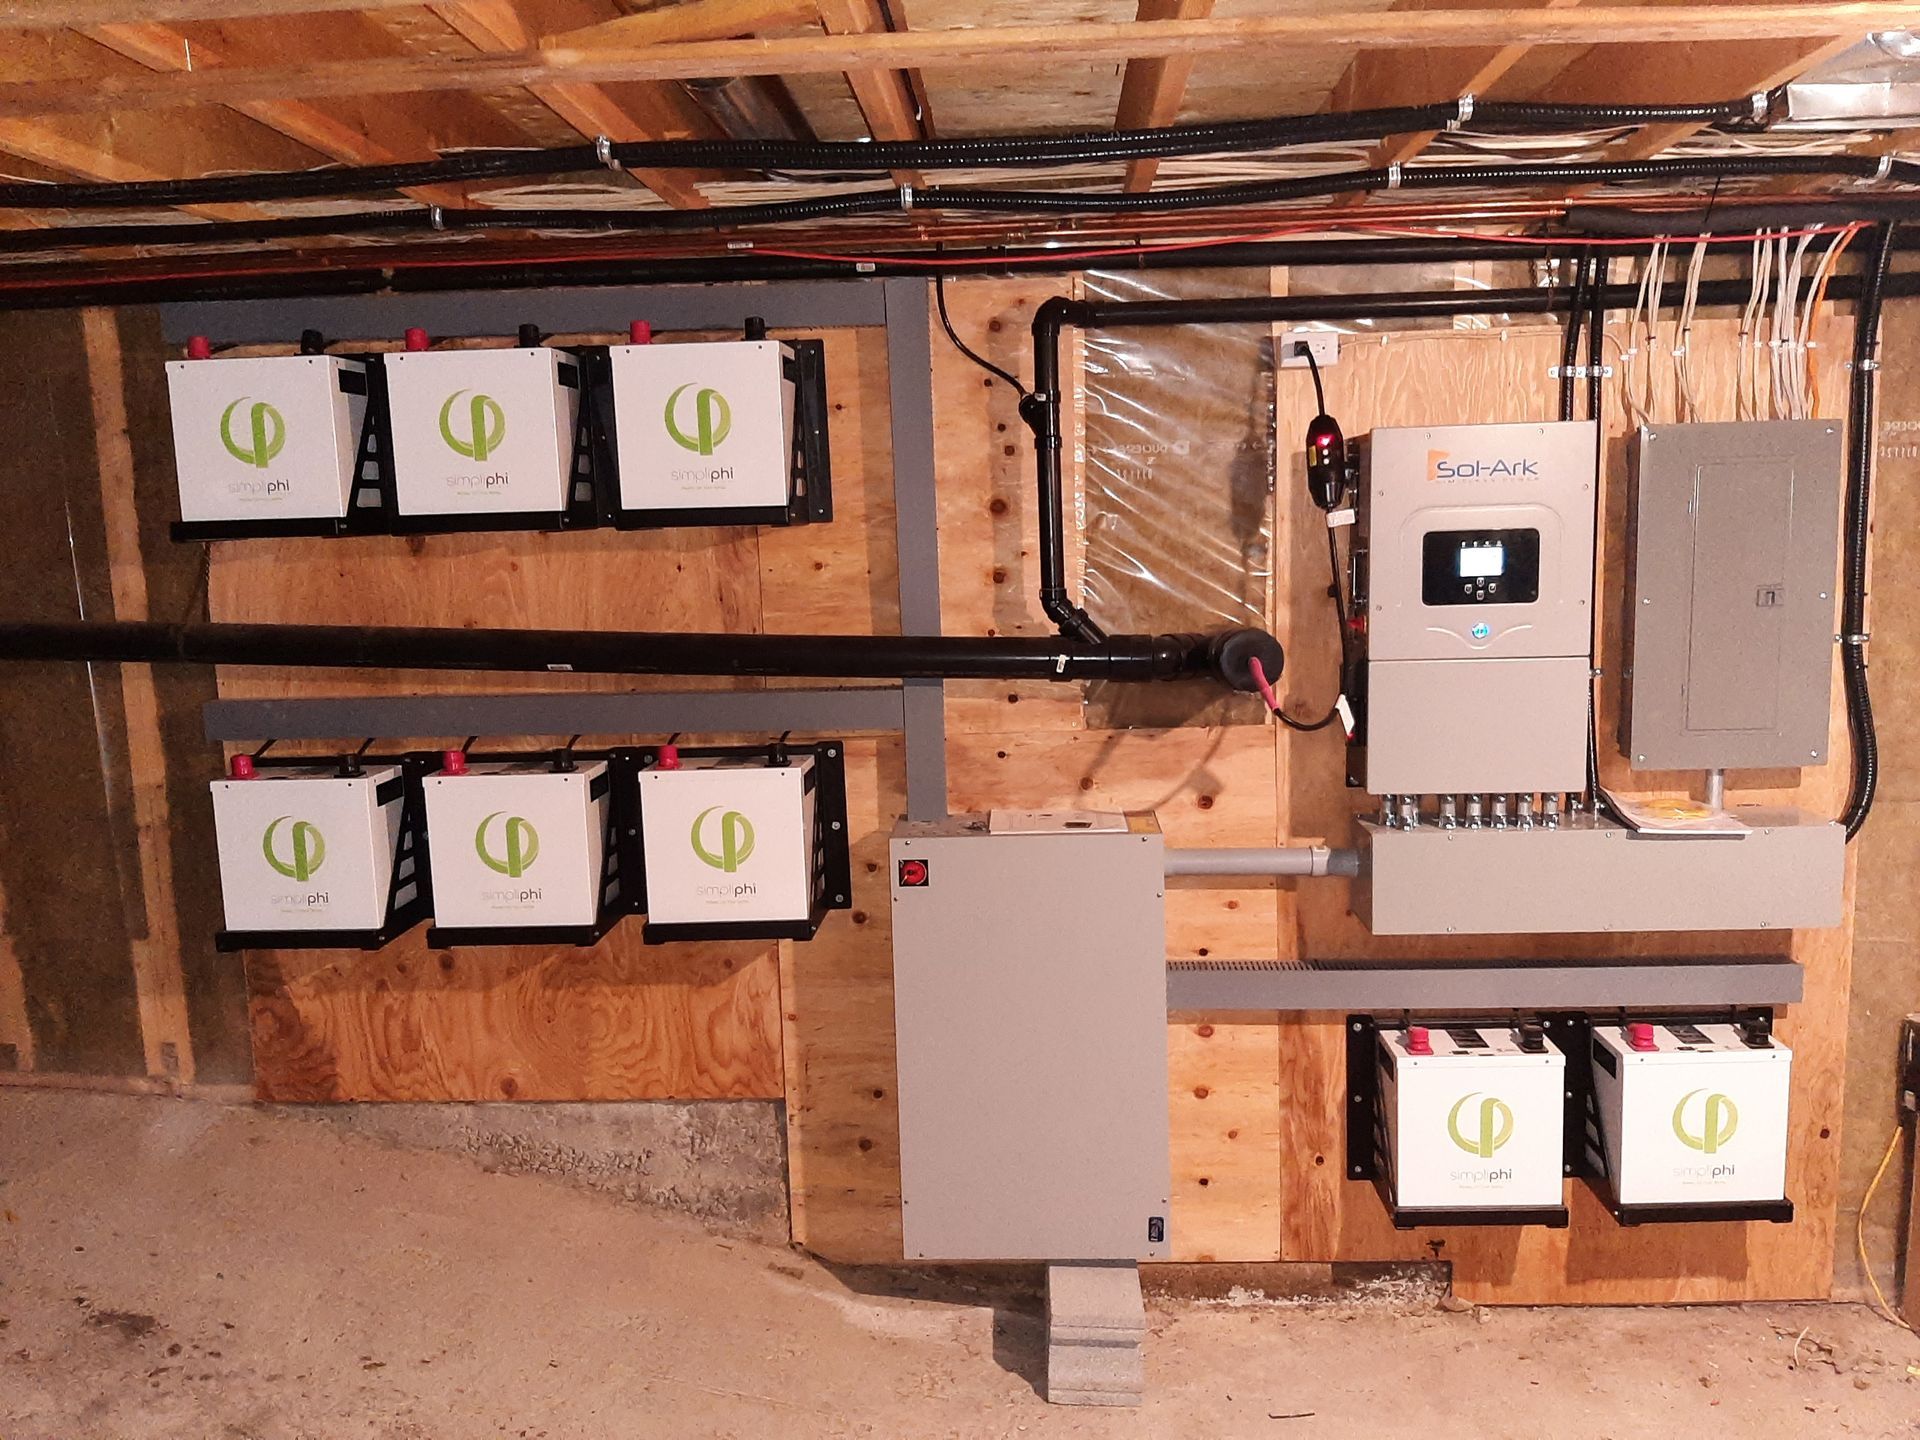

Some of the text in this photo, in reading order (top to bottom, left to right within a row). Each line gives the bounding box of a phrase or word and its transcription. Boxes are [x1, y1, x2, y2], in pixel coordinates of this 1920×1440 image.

[671, 467, 734, 483] simpliphi
[1436, 459, 1538, 478] Sol-Ark
[228, 479, 289, 495] simpliphi
[446, 472, 509, 489] simpliphi
[481, 888, 542, 903] simpliphi
[696, 883, 757, 898] simpliphi
[1449, 1168, 1512, 1183] simpliphi
[1672, 1164, 1735, 1179] simpliphi
